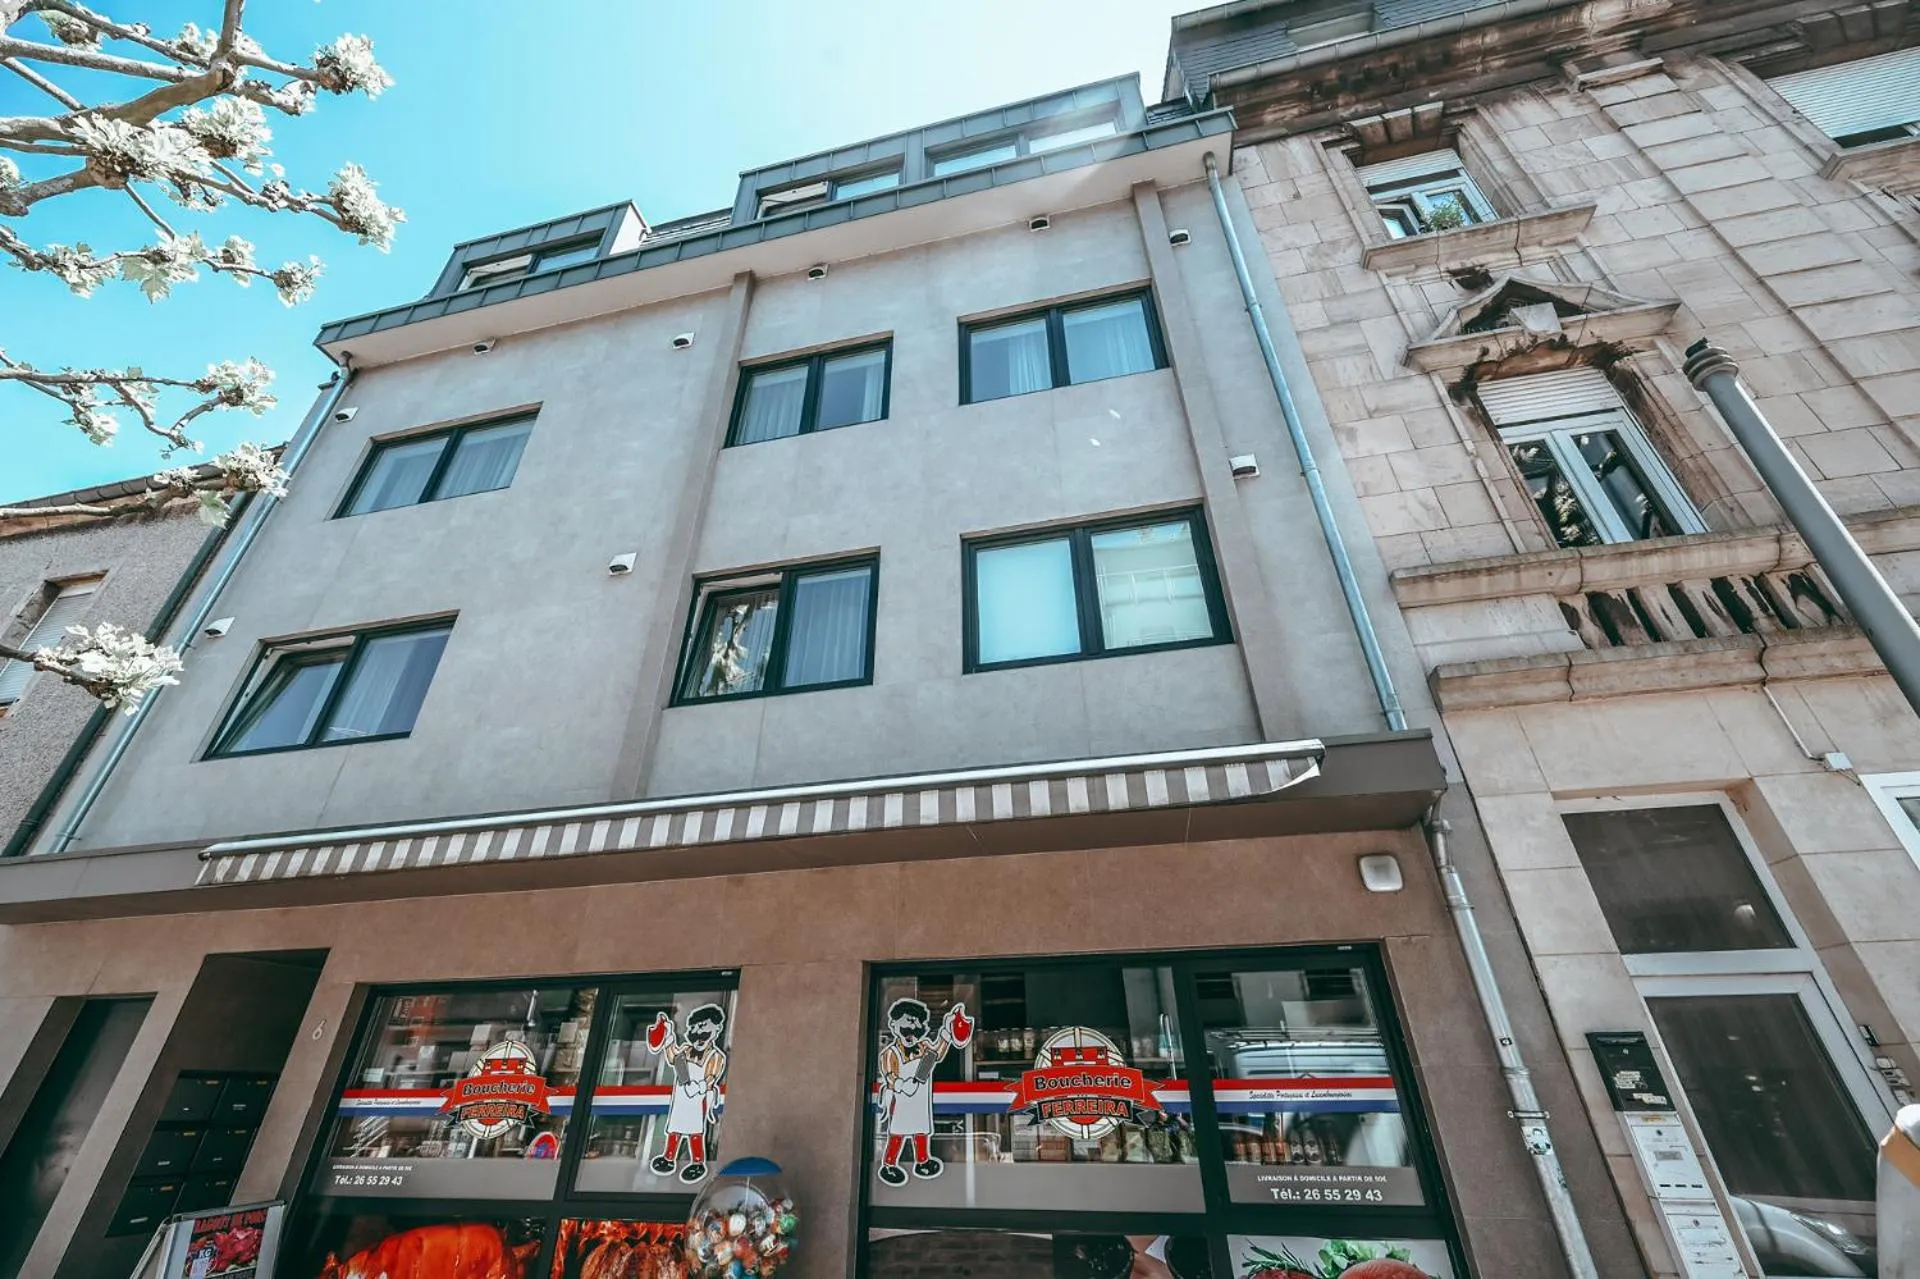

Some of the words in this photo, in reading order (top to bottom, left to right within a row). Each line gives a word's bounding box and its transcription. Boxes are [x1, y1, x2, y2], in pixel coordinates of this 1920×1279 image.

[312, 1019, 326, 1040] 6
[462, 1081, 535, 1097] Boucherie
[1034, 1072, 1132, 1090] Boucherie
[461, 1104, 525, 1120] FERREIRA
[1041, 1100, 1129, 1117] FERREIRA
[354, 1175, 365, 1186] 26
[366, 1175, 378, 1186] 55
[378, 1175, 391, 1186] 29
[391, 1176, 403, 1186] 43
[1338, 1175, 1363, 1183] PARTIR
[1270, 1188, 1301, 1200] Tél.:
[1303, 1188, 1321, 1200] 26
[1323, 1188, 1341, 1201] 55
[1344, 1189, 1362, 1201] 29
[1364, 1189, 1383, 1202] 43
[199, 1247, 213, 1259] KG
